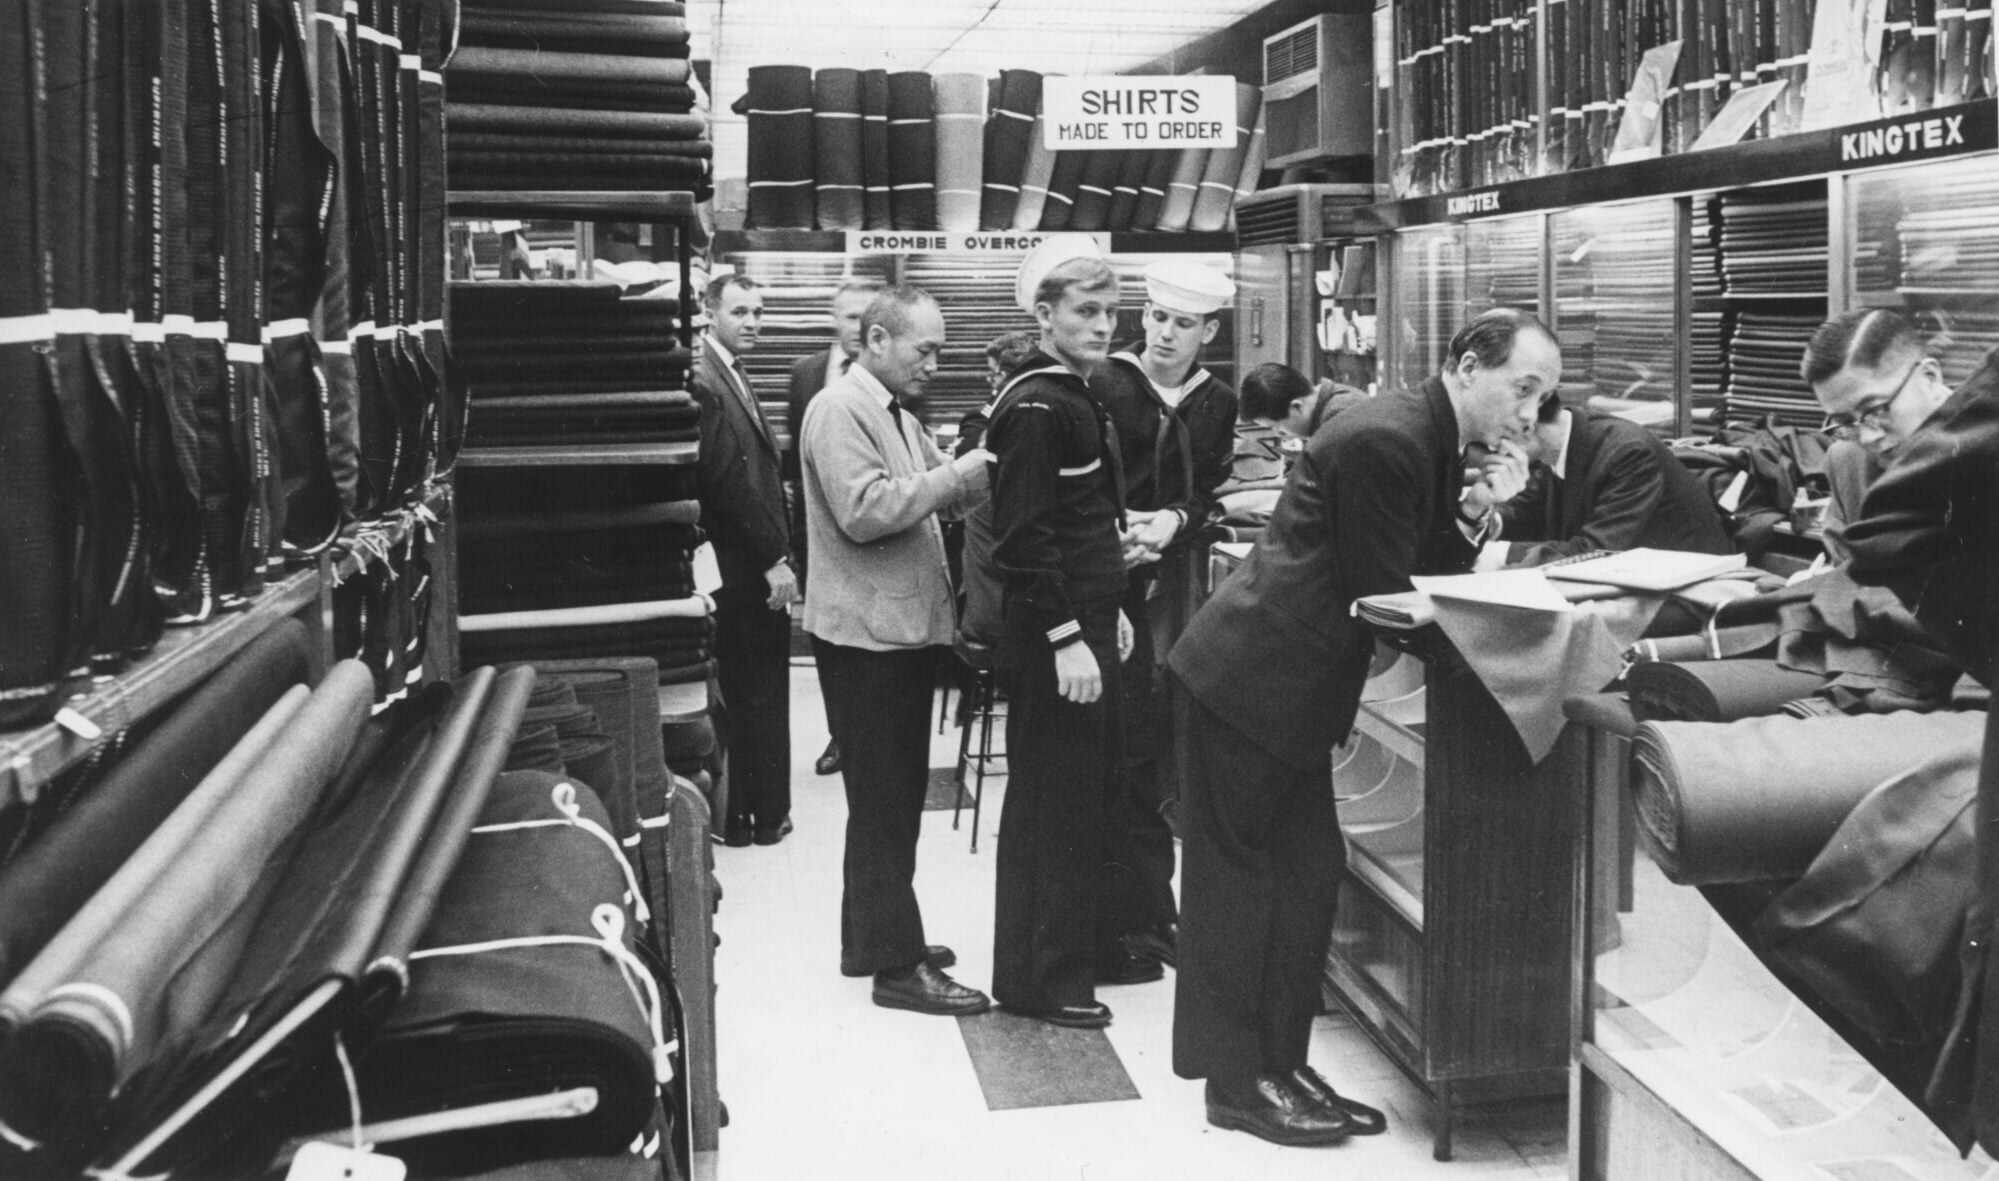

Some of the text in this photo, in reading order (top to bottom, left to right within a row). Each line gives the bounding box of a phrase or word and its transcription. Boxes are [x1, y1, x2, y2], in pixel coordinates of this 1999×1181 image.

[1081, 89, 1200, 115] SHIRTS
[1059, 121, 1222, 140] MADE TO ORDER
[1842, 114, 1964, 161] KINGTEX
[1447, 190, 1500, 217] KINGTEX
[859, 236, 947, 250] CROMBIE
